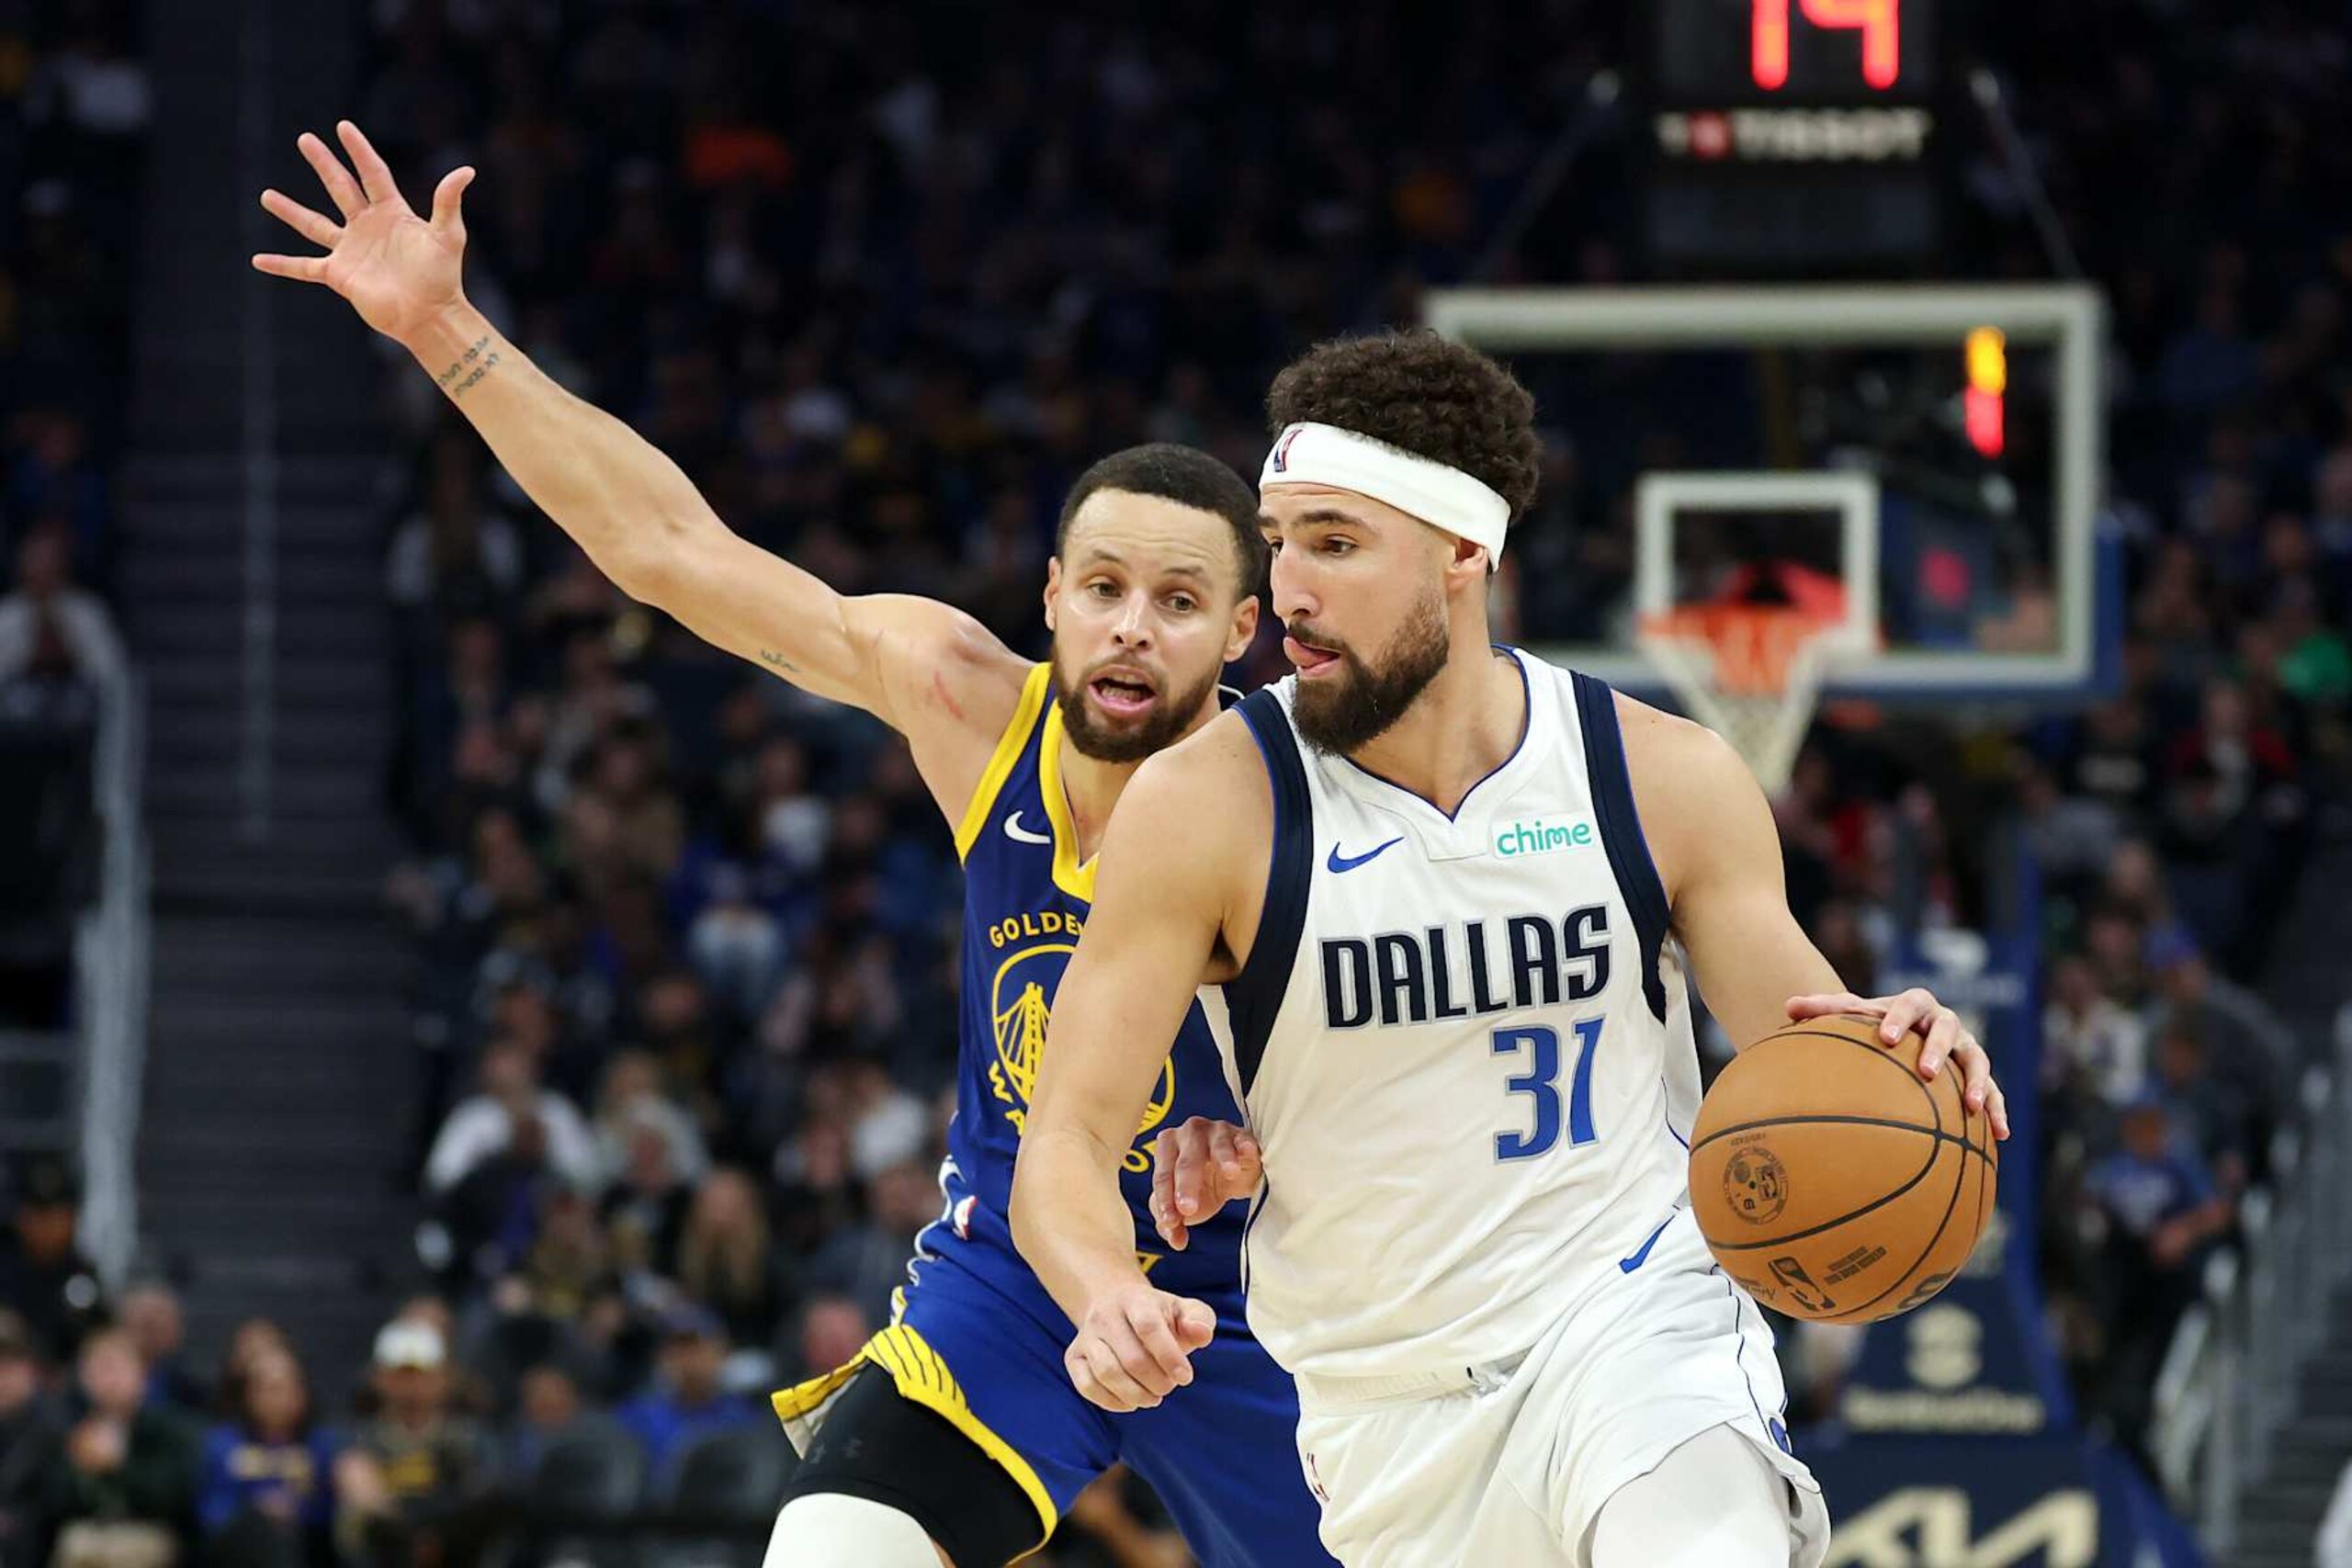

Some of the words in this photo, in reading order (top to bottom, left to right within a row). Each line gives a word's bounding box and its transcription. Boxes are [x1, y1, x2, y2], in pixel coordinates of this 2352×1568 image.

[1497, 820, 1591, 854] chime
[990, 912, 1082, 948] GOLDE
[1317, 901, 1611, 1030] DALLAS
[1489, 1014, 1607, 1165] 31
